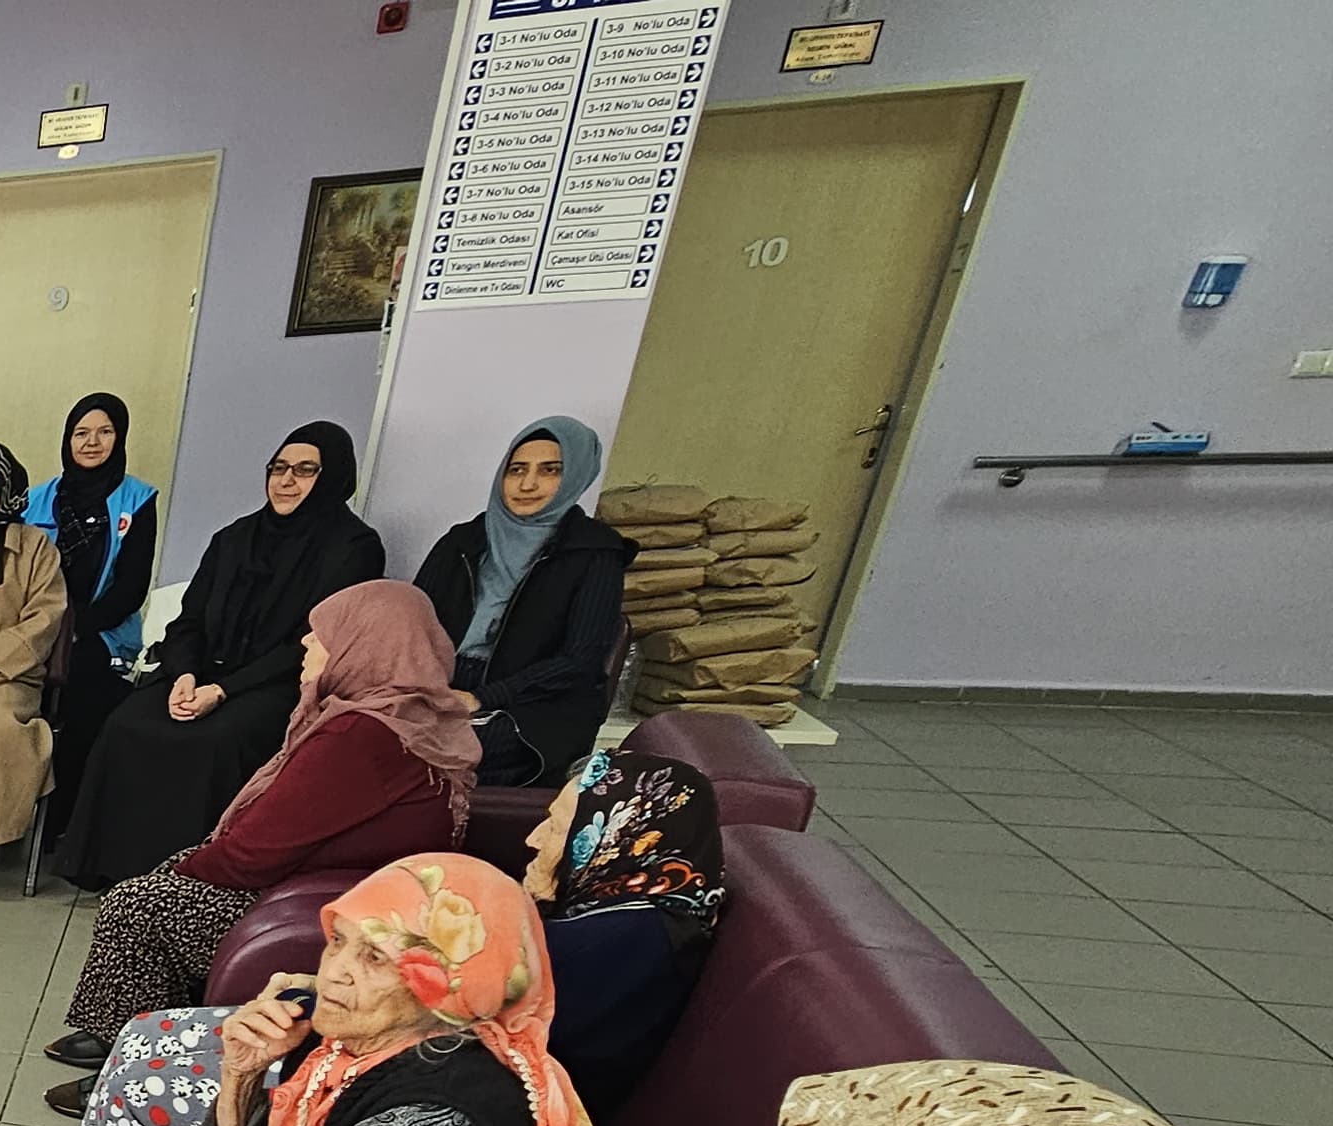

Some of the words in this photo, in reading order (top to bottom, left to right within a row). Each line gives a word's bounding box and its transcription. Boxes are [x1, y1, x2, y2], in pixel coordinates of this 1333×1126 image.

[607, 23, 624, 33] 3-9
[667, 17, 690, 27] Oda
[500, 35, 517, 45] 3-1
[554, 29, 577, 38] Oda
[600, 49, 624, 61] 3-10
[661, 44, 684, 54] Oda
[494, 61, 512, 71] 3-2
[548, 55, 571, 65] Oda
[594, 76, 617, 87] 3-11
[654, 71, 677, 80] Oda
[488, 87, 506, 97] 3-3
[542, 81, 565, 91] Oda
[587, 103, 612, 113] 3-12
[648, 97, 670, 107] Oda
[482, 113, 500, 123] 3-4
[536, 108, 559, 117] Oda
[581, 129, 605, 139] 3-13
[641, 124, 664, 133] Oda
[477, 139, 494, 149] 3-5
[530, 134, 552, 144] Oda
[575, 154, 599, 165] 3-14
[635, 150, 657, 159] Oda
[471, 164, 488, 174] 3-6
[524, 160, 546, 169] Oda
[569, 180, 593, 190] 3-15
[628, 176, 651, 185] Oda
[466, 189, 483, 199] 3-7
[518, 185, 541, 194] Oda
[513, 210, 535, 219] Oda
[562, 204, 604, 215] Asansör
[457, 237, 495, 247] Temizlik
[500, 235, 530, 244] Odası
[557, 231, 574, 239] Kat
[607, 252, 633, 260] Odası
[744, 237, 789, 268] 10
[546, 279, 565, 288] WC
[48, 287, 69, 311] 9
